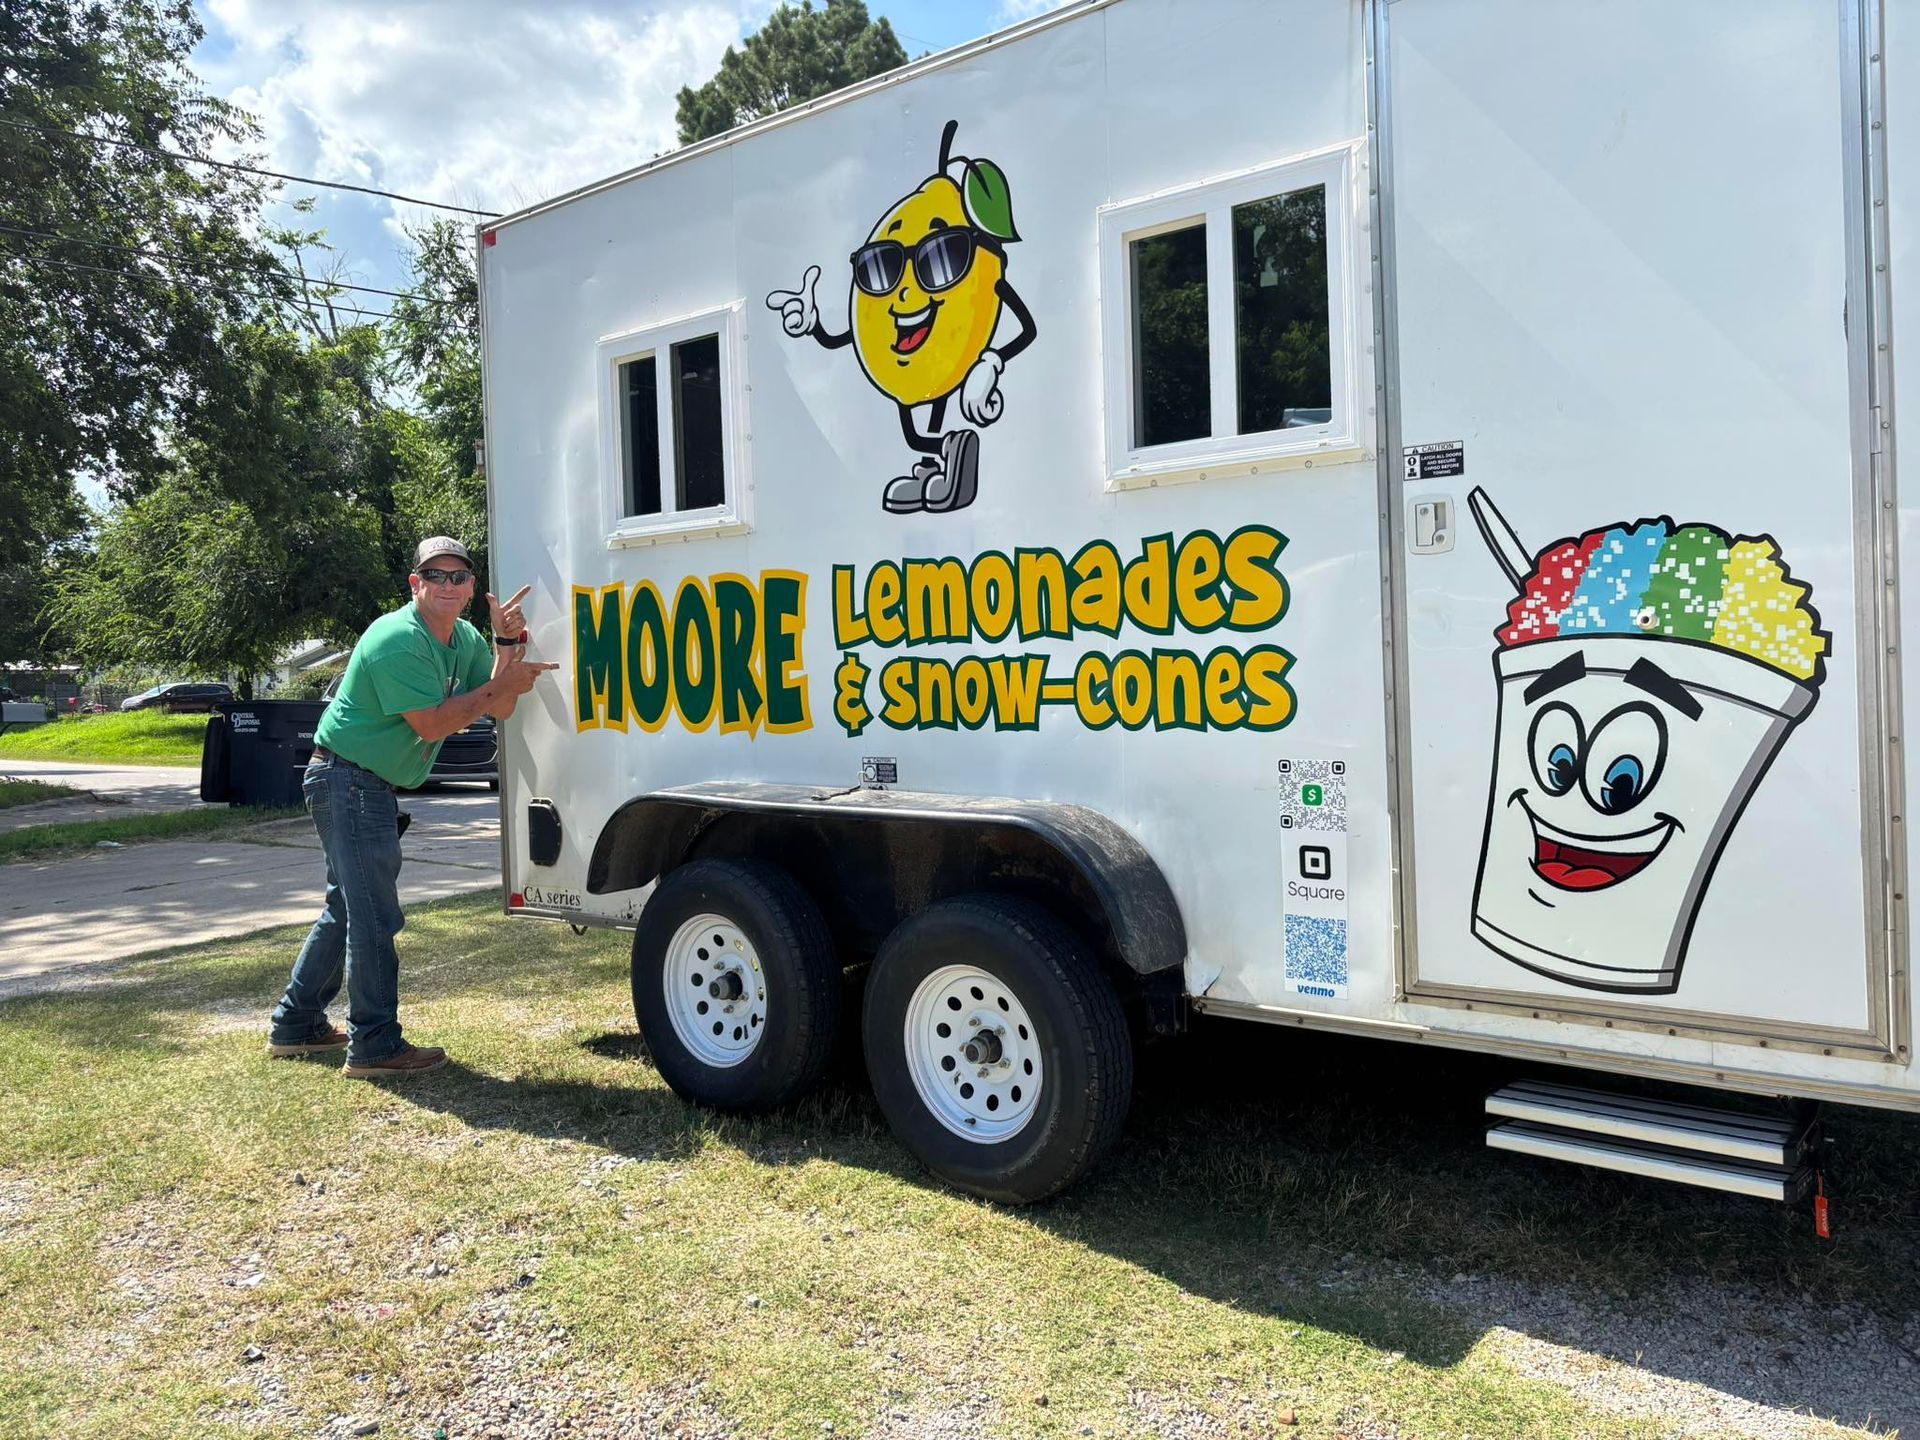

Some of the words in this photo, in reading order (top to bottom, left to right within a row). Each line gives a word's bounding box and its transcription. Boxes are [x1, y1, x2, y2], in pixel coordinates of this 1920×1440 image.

[1421, 443, 1454, 453] CAUTION
[832, 524, 1290, 649] Lemonades
[572, 569, 814, 742] MOORE
[833, 651, 874, 737] &
[231, 712, 255, 722] CENTRAL
[524, 886, 543, 903] CA
[547, 890, 581, 906] series
[1288, 881, 1345, 901] Square
[1297, 984, 1335, 998] venmo
